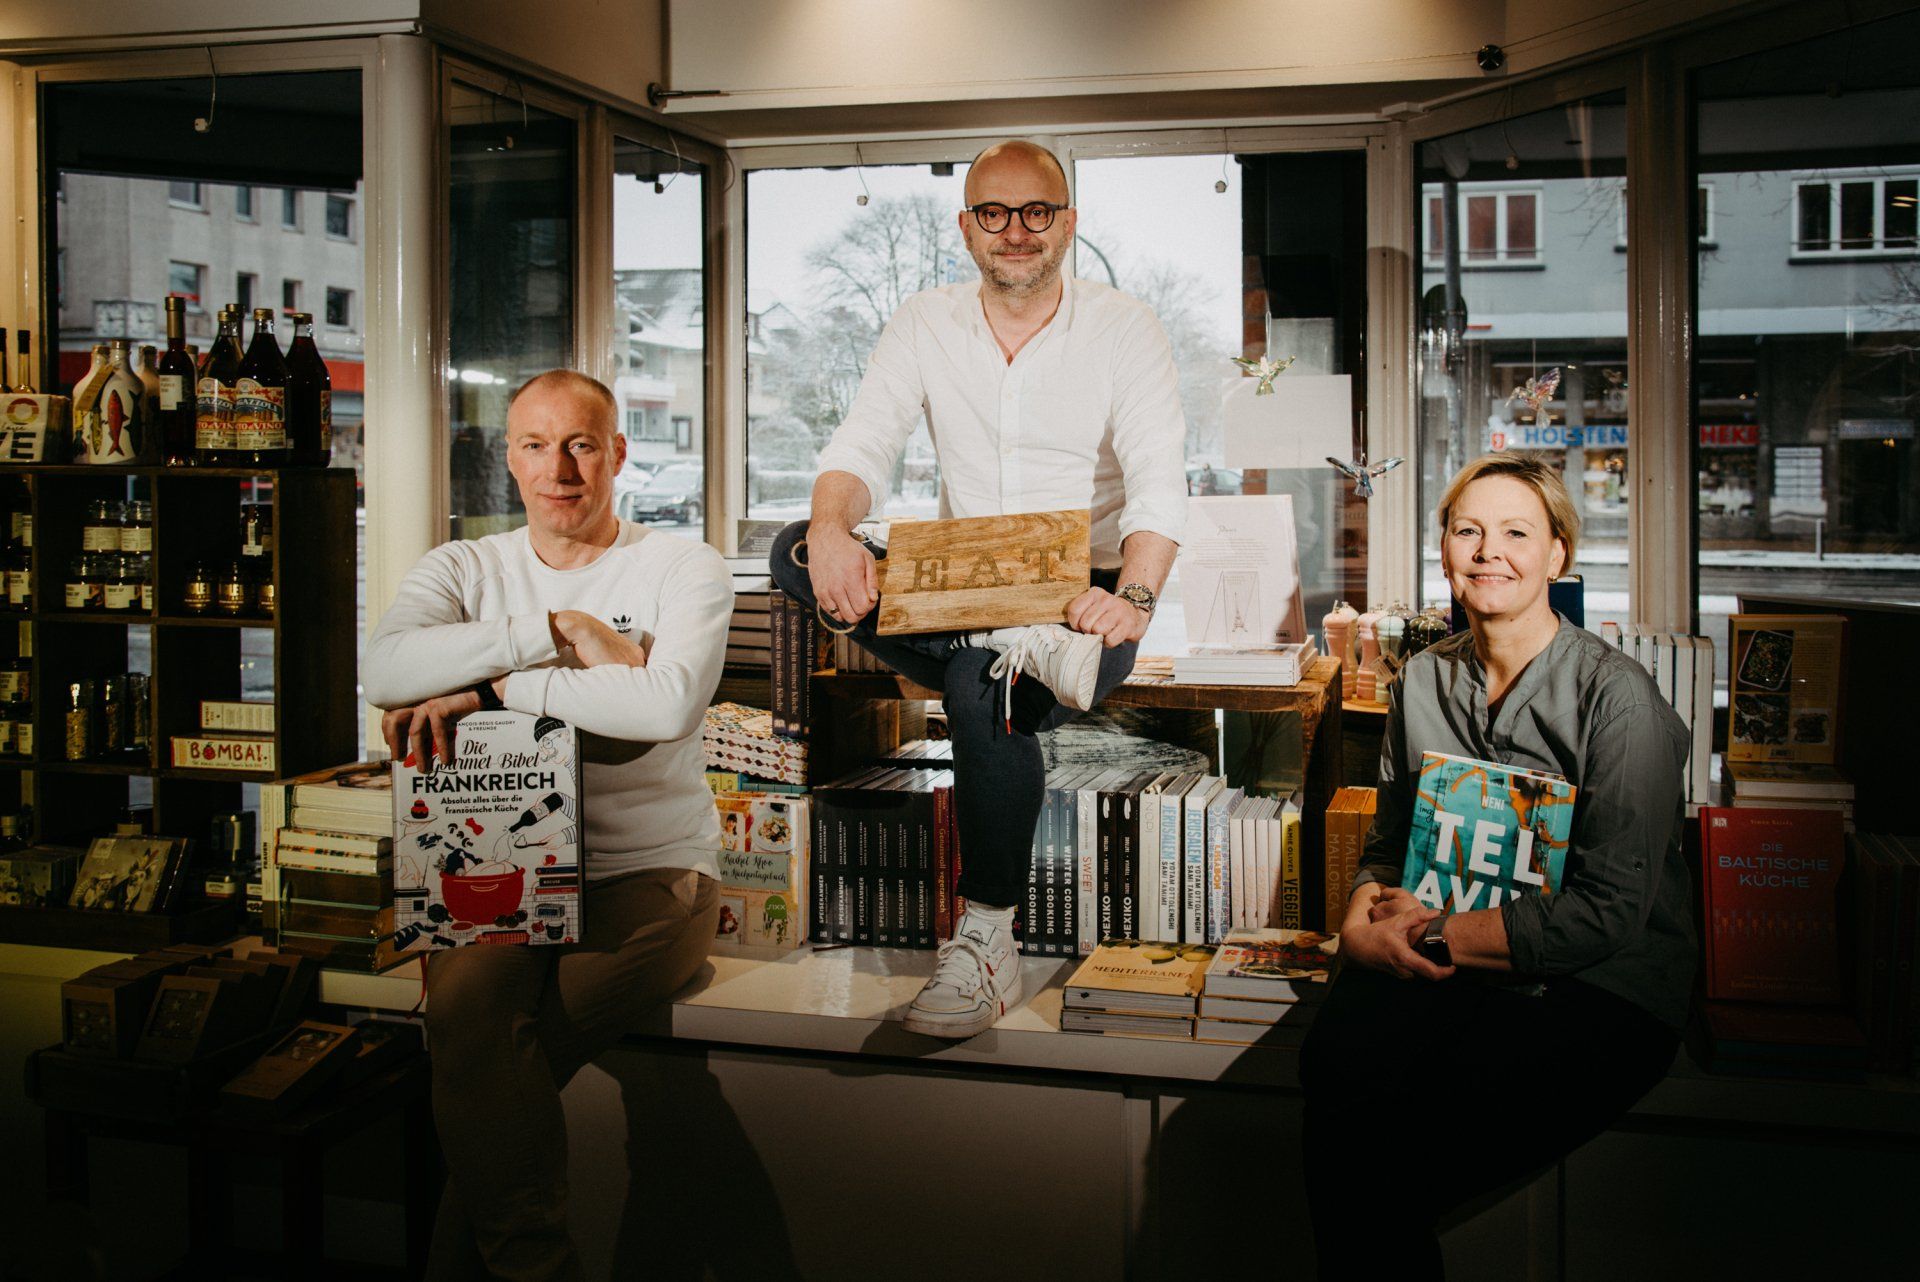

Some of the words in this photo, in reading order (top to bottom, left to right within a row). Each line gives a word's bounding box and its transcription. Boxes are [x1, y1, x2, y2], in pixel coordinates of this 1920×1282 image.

[1524, 427, 1628, 445] HOLSTEN
[903, 545, 1067, 594] EAT
[463, 739, 488, 756] Die
[500, 752, 540, 770] Bibel
[412, 772, 556, 794] FRANKREICH
[441, 797, 471, 806] Absolut
[473, 796, 490, 804] alles
[492, 795, 510, 804] über
[511, 794, 523, 803] die
[445, 805, 493, 815] französische
[494, 803, 519, 813] Küche
[1162, 804, 1176, 860] JERUSALEM
[1187, 808, 1202, 863] JERUSALEM
[1433, 809, 1545, 887] TEL
[1762, 843, 1784, 853] DIE
[1046, 844, 1054, 884] WINTER
[1064, 845, 1072, 885] WINTER
[1082, 856, 1092, 894] SWEET
[1328, 833, 1340, 911] MALLORCA
[1718, 855, 1831, 871] BALTISCHE
[1739, 871, 1810, 888] KÜCHE
[1029, 887, 1037, 934] COOKING
[1046, 887, 1054, 935] COOKING
[1064, 888, 1072, 936] COOKING
[1284, 878, 1298, 930] VEGGIES
[1413, 869, 1522, 913] AVI
[1102, 895, 1111, 939] MEXIKO
[1123, 896, 1132, 940] MEXIKO
